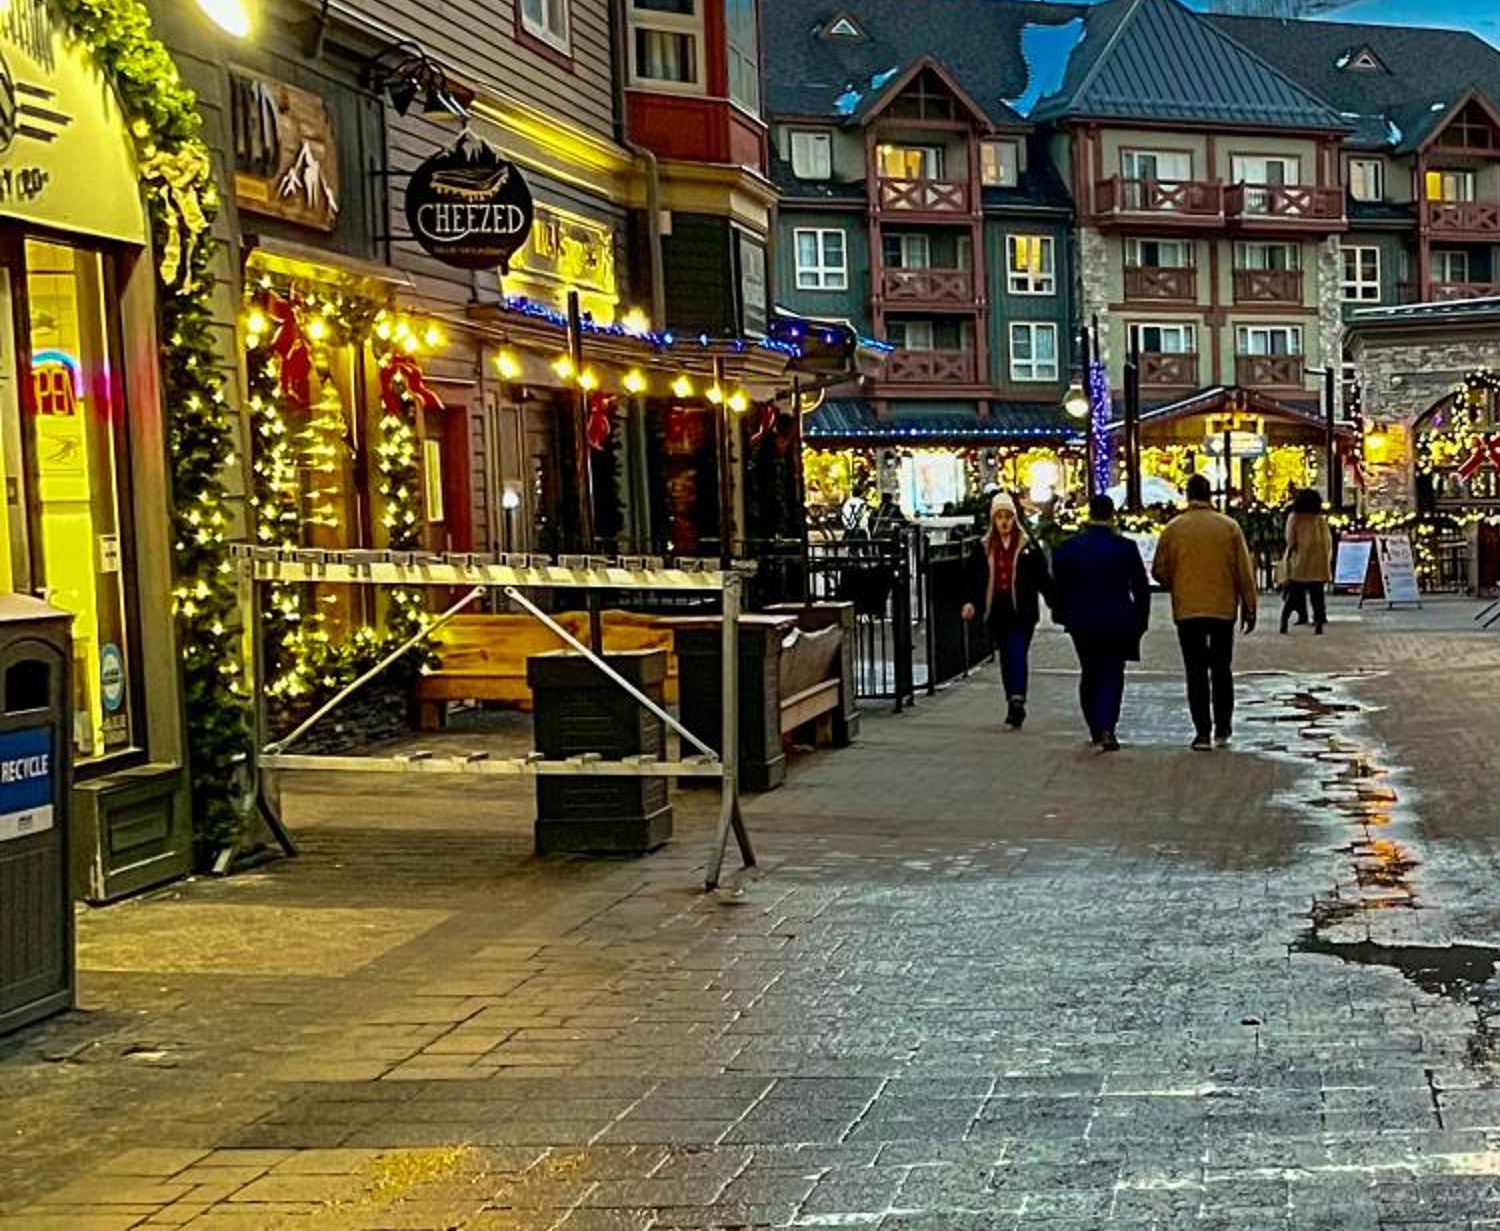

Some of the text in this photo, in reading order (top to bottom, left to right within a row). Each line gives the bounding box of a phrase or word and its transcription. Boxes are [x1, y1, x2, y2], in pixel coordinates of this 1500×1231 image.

[417, 203, 524, 242] CHEEZED
[32, 366, 77, 416] PEN
[1, 754, 49, 784] RECYCLE
